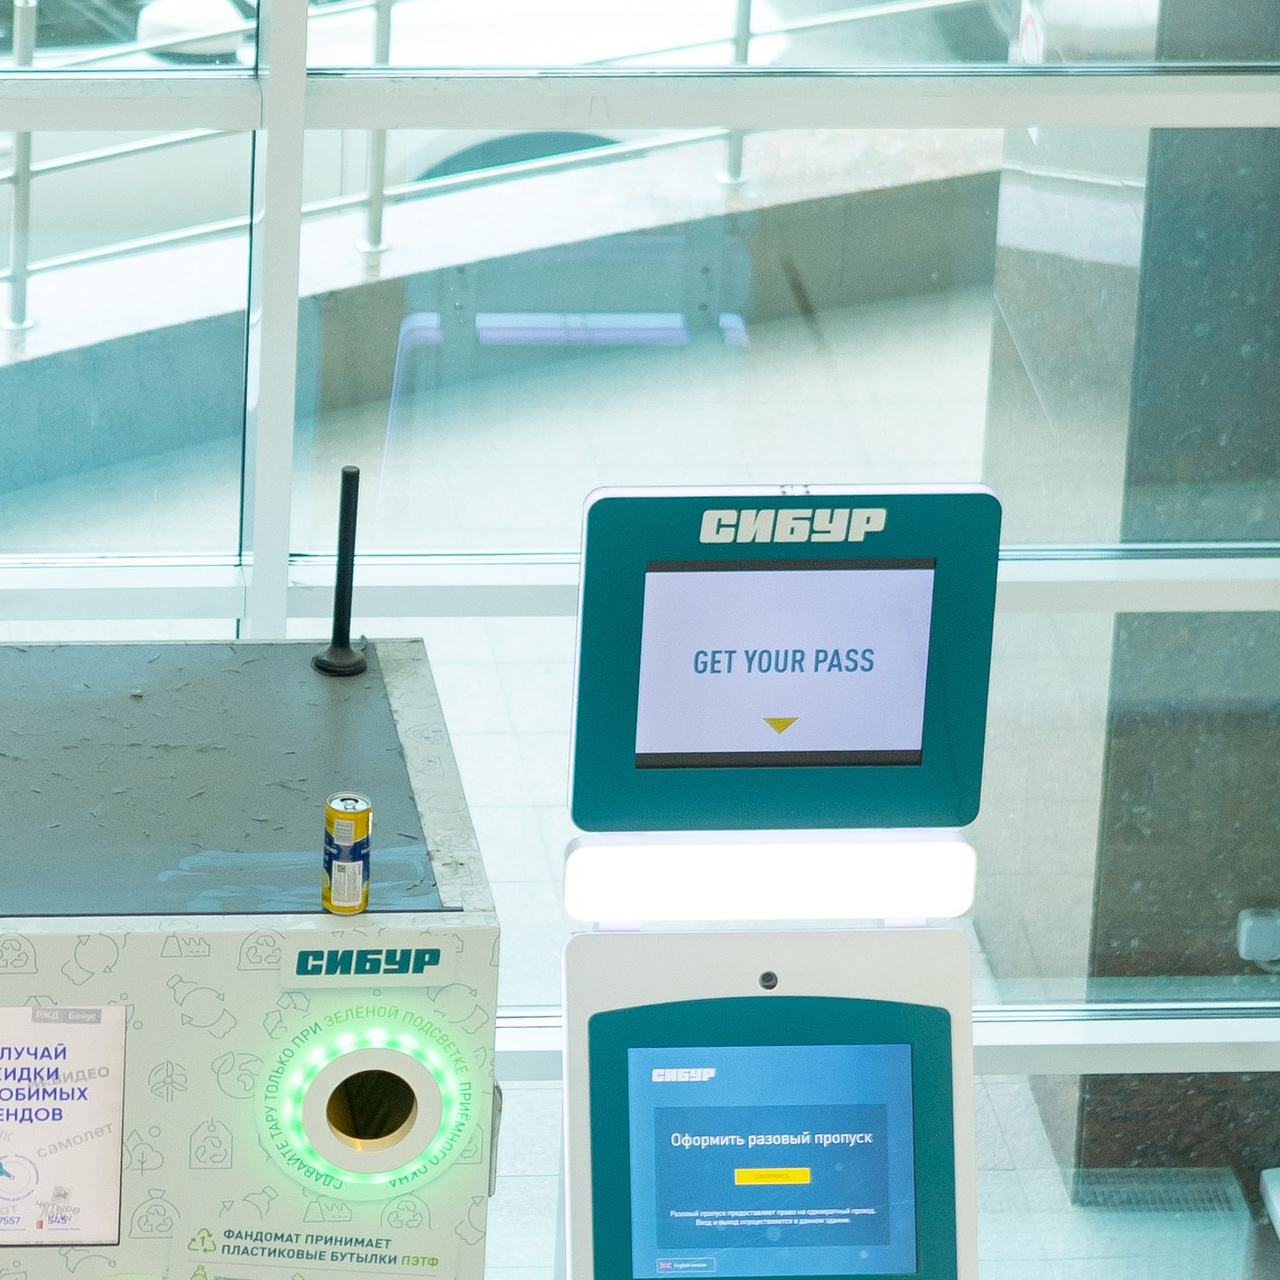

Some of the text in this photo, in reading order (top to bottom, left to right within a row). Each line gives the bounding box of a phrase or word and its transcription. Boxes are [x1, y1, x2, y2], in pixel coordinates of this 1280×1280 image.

[699, 508, 887, 544] СИБУР
[693, 648, 875, 675] GET YOUR PASS
[295, 949, 442, 976] СИБУР
[291, 1022, 323, 1048] ПРИ
[402, 1011, 469, 1075] ПОДСВЕТКЕ
[265, 1048, 294, 1101] ТОЛЬКО
[652, 1067, 716, 1082] СИБУР
[265, 1106, 283, 1141] ТАРУ
[36, 1123, 113, 1158] самолет
[670, 1130, 874, 1150] Оформить разовый пропуск
[275, 1140, 343, 1189] СДАВАЙТЕ
[223, 1228, 392, 1250] ФАНДОМАТ ПРИНИМАЕТ
[221, 1245, 440, 1268] ПЛАСТИКОВЫЕ БУТЫЛКИ ПЭТФ
